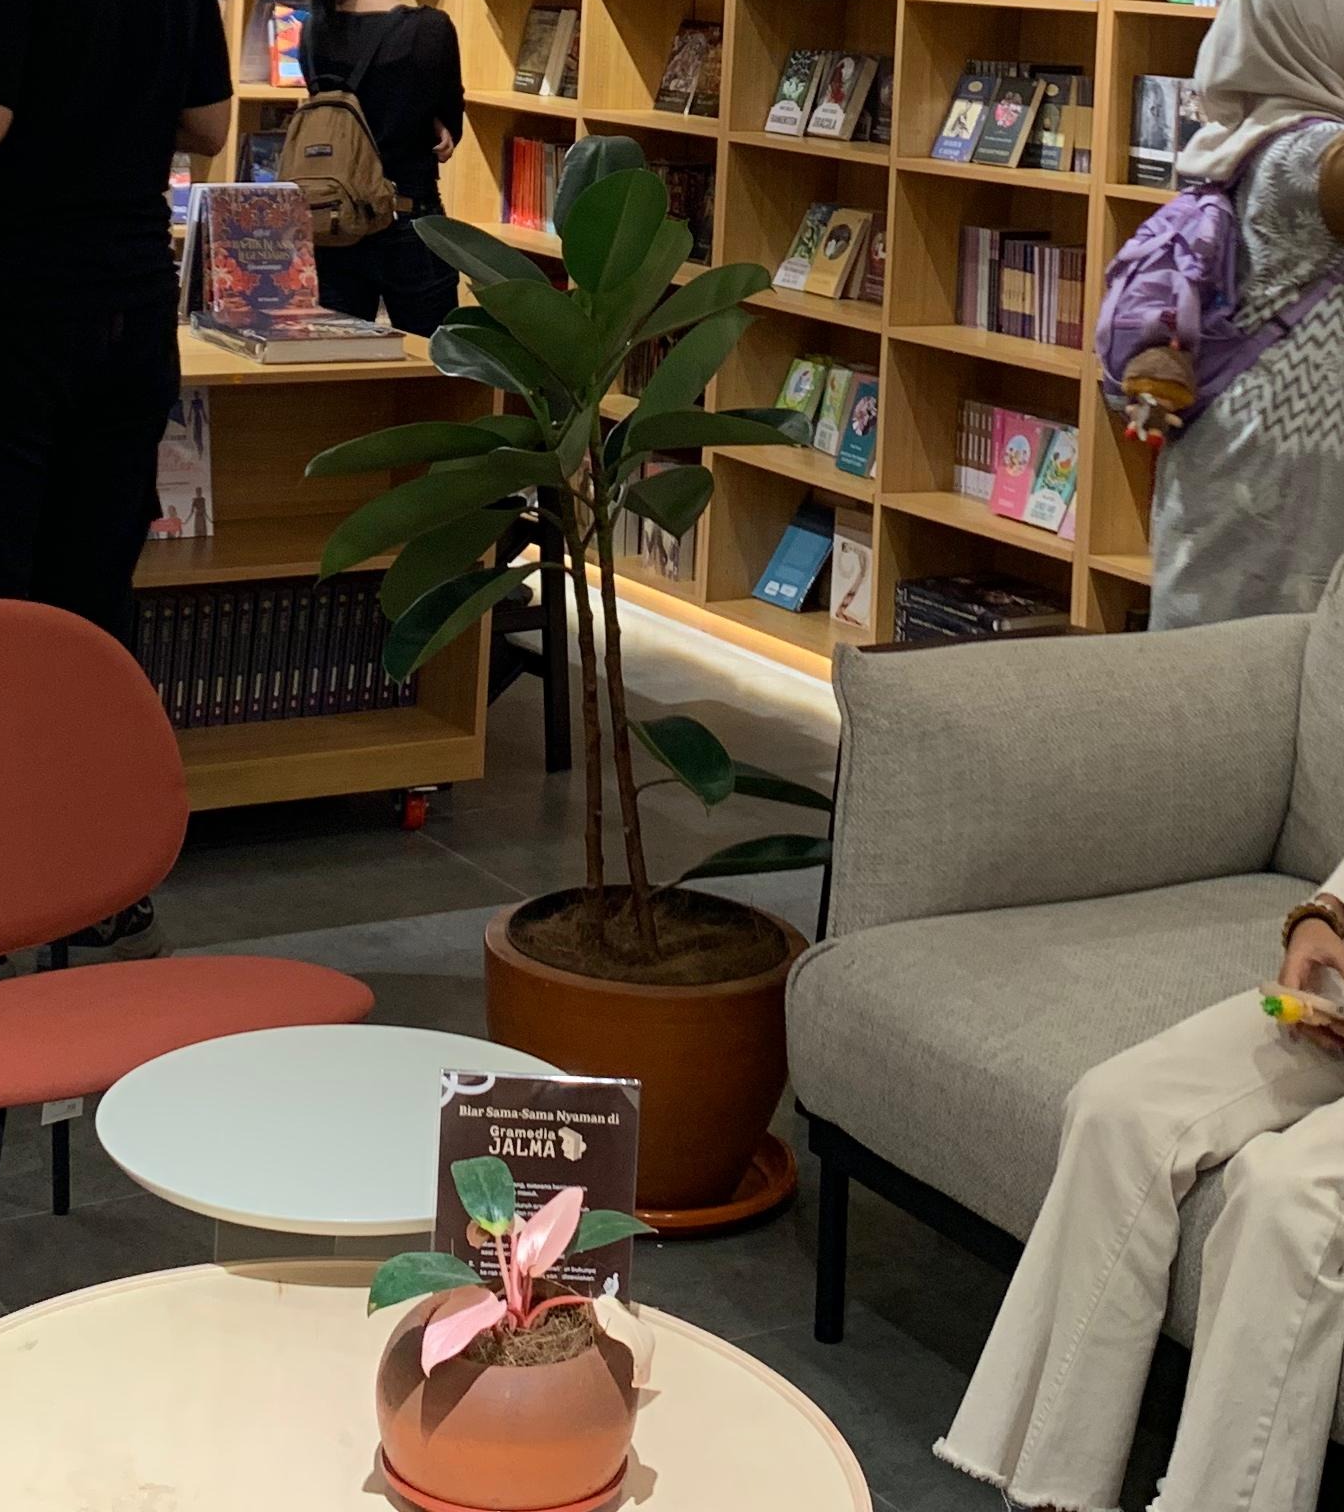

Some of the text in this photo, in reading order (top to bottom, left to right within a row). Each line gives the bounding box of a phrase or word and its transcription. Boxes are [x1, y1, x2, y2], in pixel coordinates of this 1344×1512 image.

[459, 1105, 620, 1125] Biar Sama-Sama Nyaman di
[490, 1125, 556, 1140] Gramedia
[489, 1138, 556, 1158] JALMA
